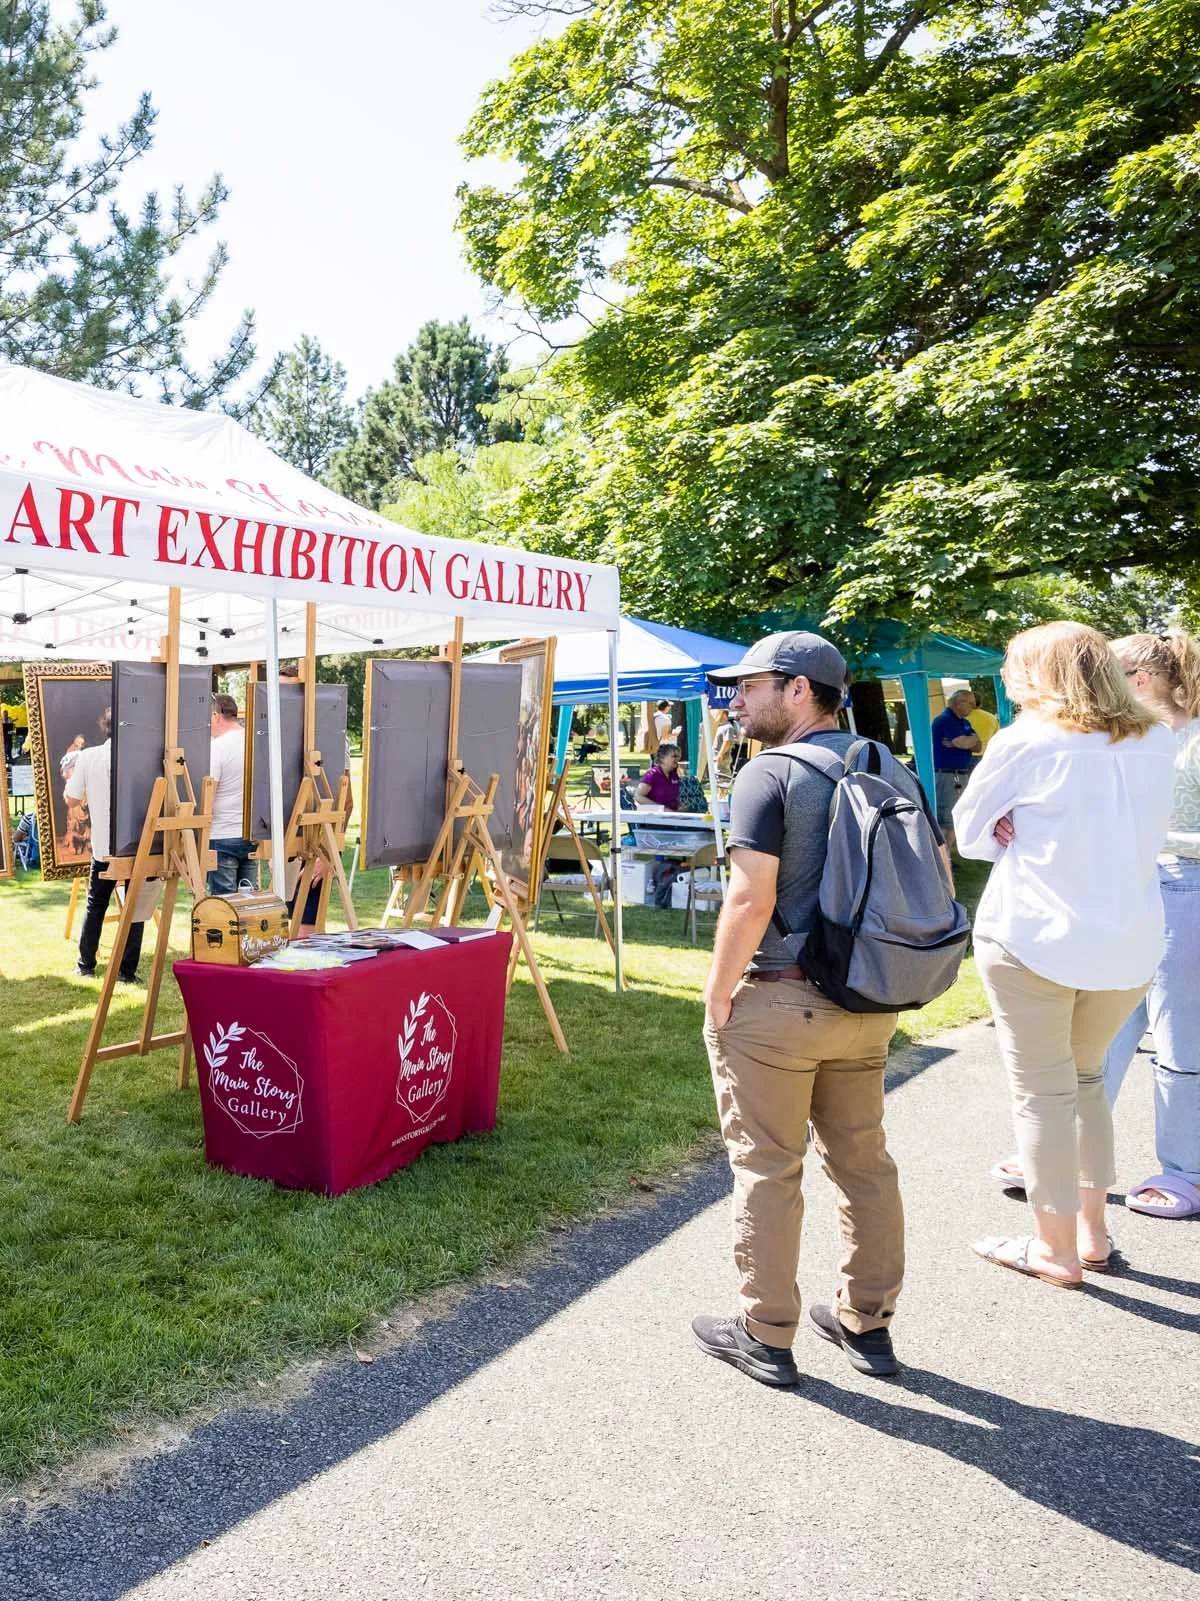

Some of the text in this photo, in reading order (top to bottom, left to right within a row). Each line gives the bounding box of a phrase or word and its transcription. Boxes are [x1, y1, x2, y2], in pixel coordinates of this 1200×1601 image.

[5, 481, 141, 558] ART
[152, 504, 437, 596] EXHIBITION
[445, 552, 593, 613] GALLERY
[420, 1014, 437, 1047] The
[239, 1047, 265, 1072] The
[400, 1046, 452, 1082] Main Story
[214, 1068, 297, 1110] Main Story
[407, 1078, 444, 1104] Gallery
[228, 1097, 287, 1126] Gallery
